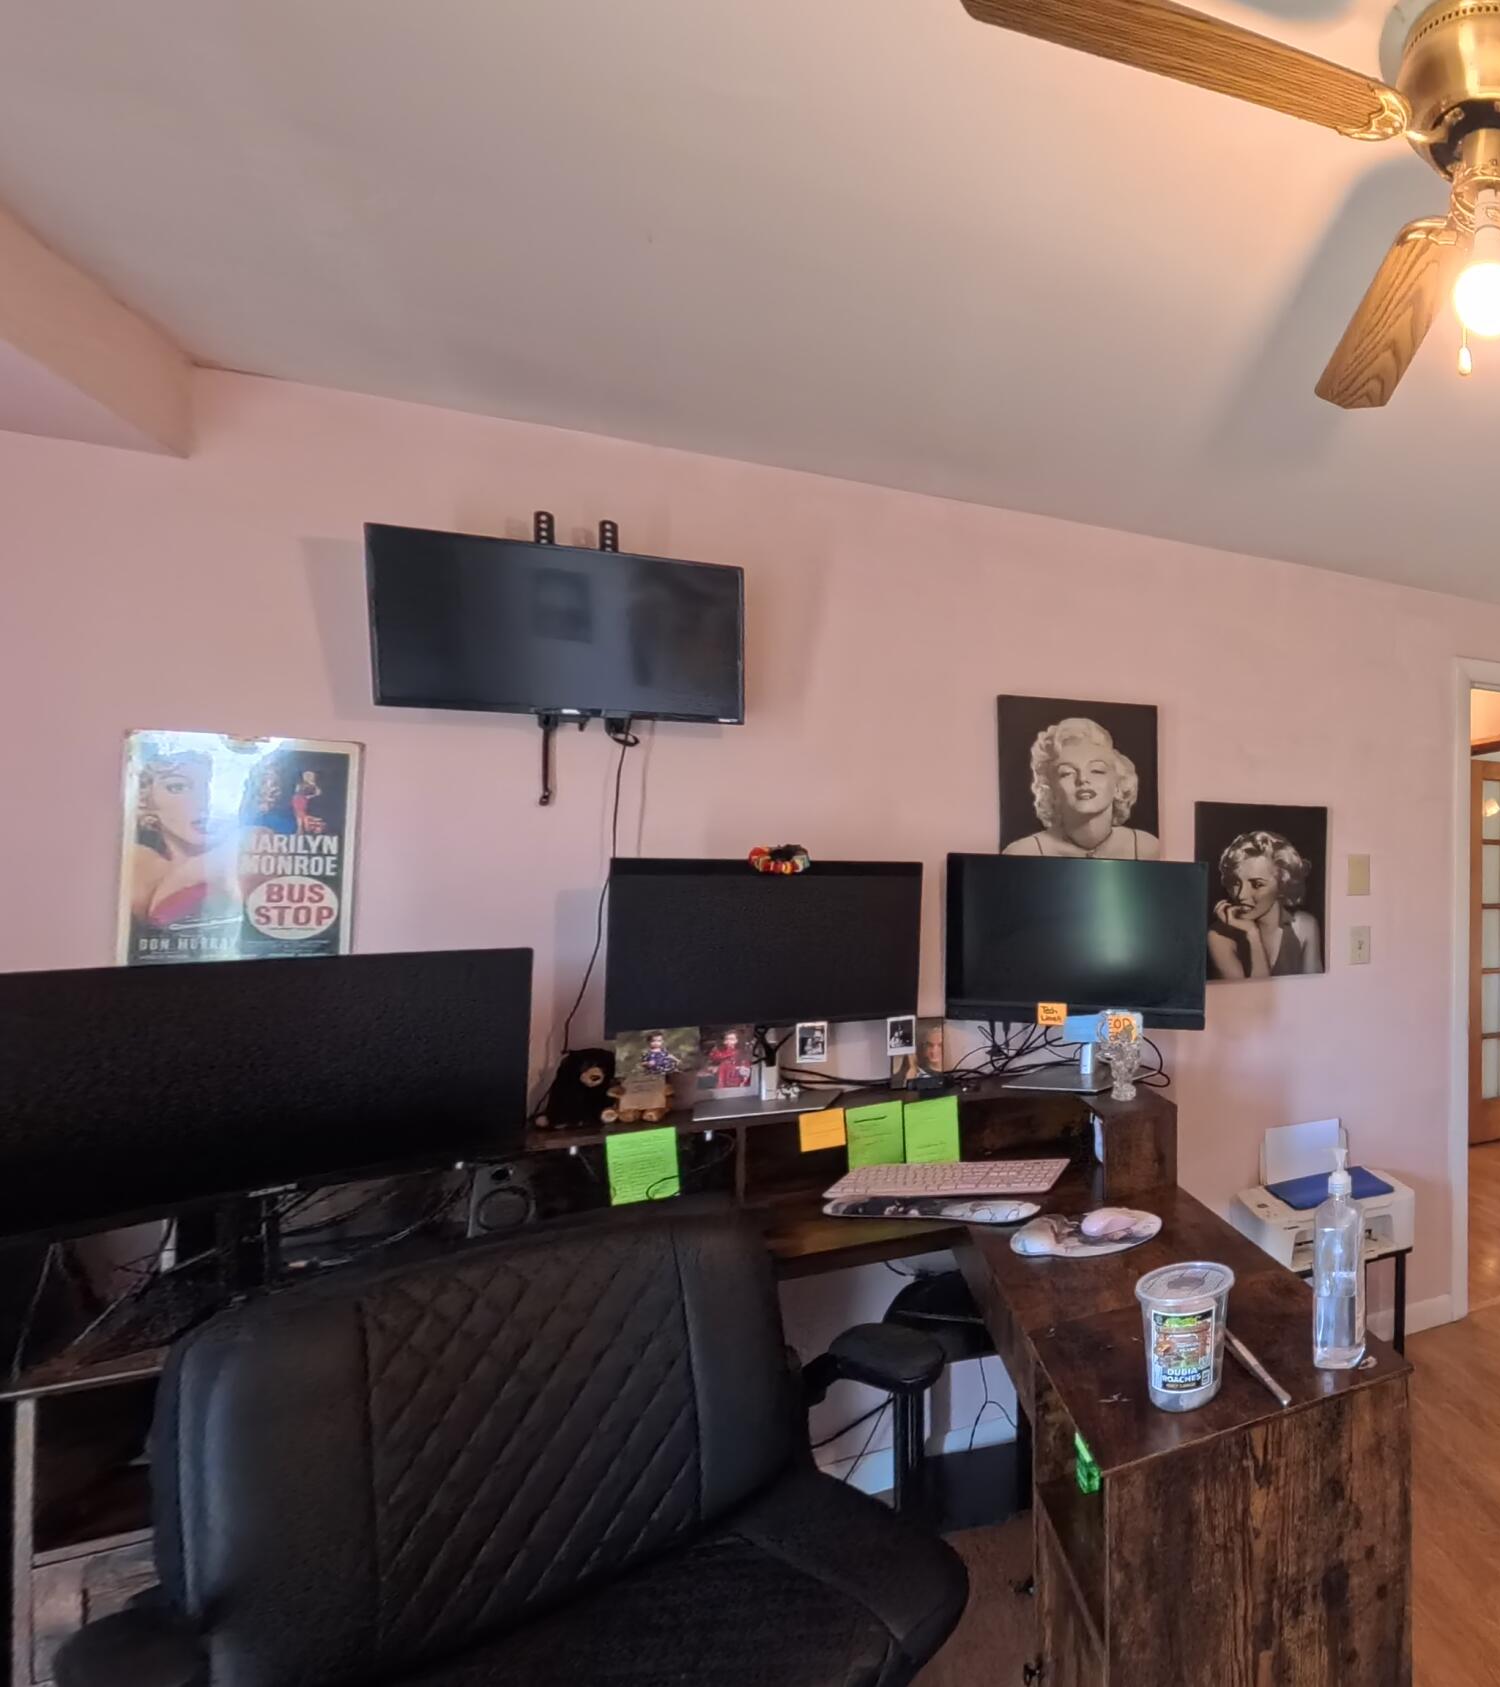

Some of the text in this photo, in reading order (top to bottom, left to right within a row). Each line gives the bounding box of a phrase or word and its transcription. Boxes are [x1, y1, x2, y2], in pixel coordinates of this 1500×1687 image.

[241, 854, 338, 876] MONROE
[265, 883, 325, 904] BUS
[254, 905, 334, 926] STOP
[138, 938, 169, 951] DON
[1161, 1373, 1202, 1383] ROACHES
[1167, 1367, 1198, 1376] DUBIA
